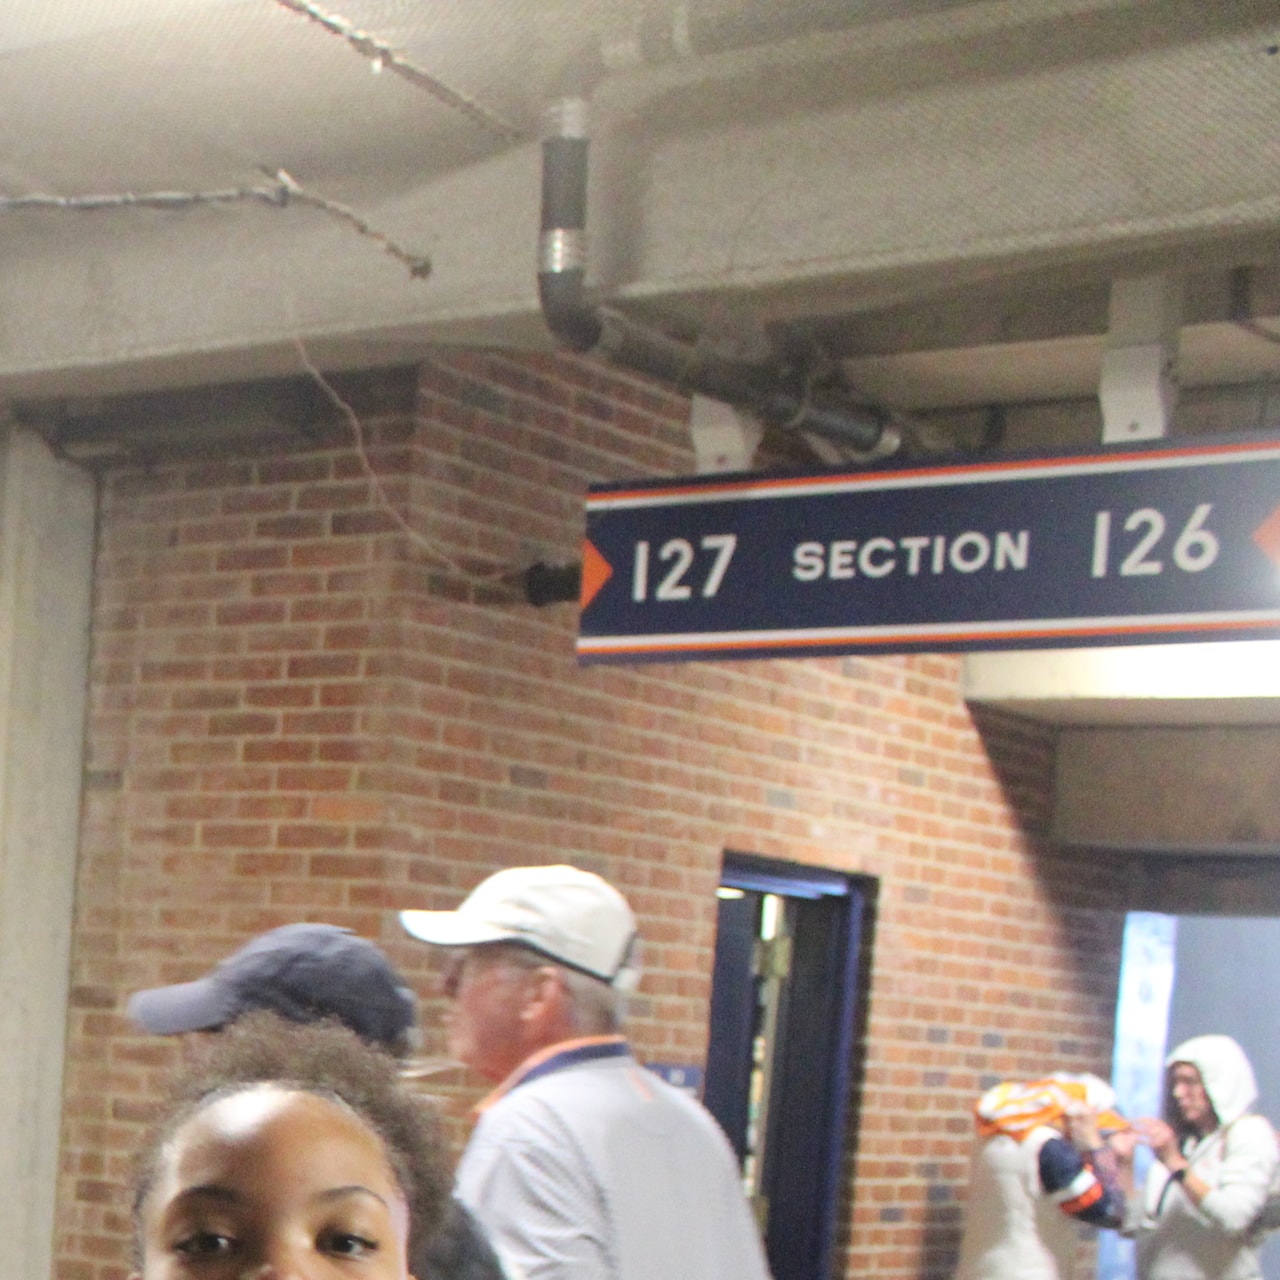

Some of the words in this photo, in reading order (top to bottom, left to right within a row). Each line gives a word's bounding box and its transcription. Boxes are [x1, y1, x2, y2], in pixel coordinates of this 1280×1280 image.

[633, 534, 737, 602] 127
[791, 531, 1030, 581] SECTION
[1092, 503, 1220, 577] 126
